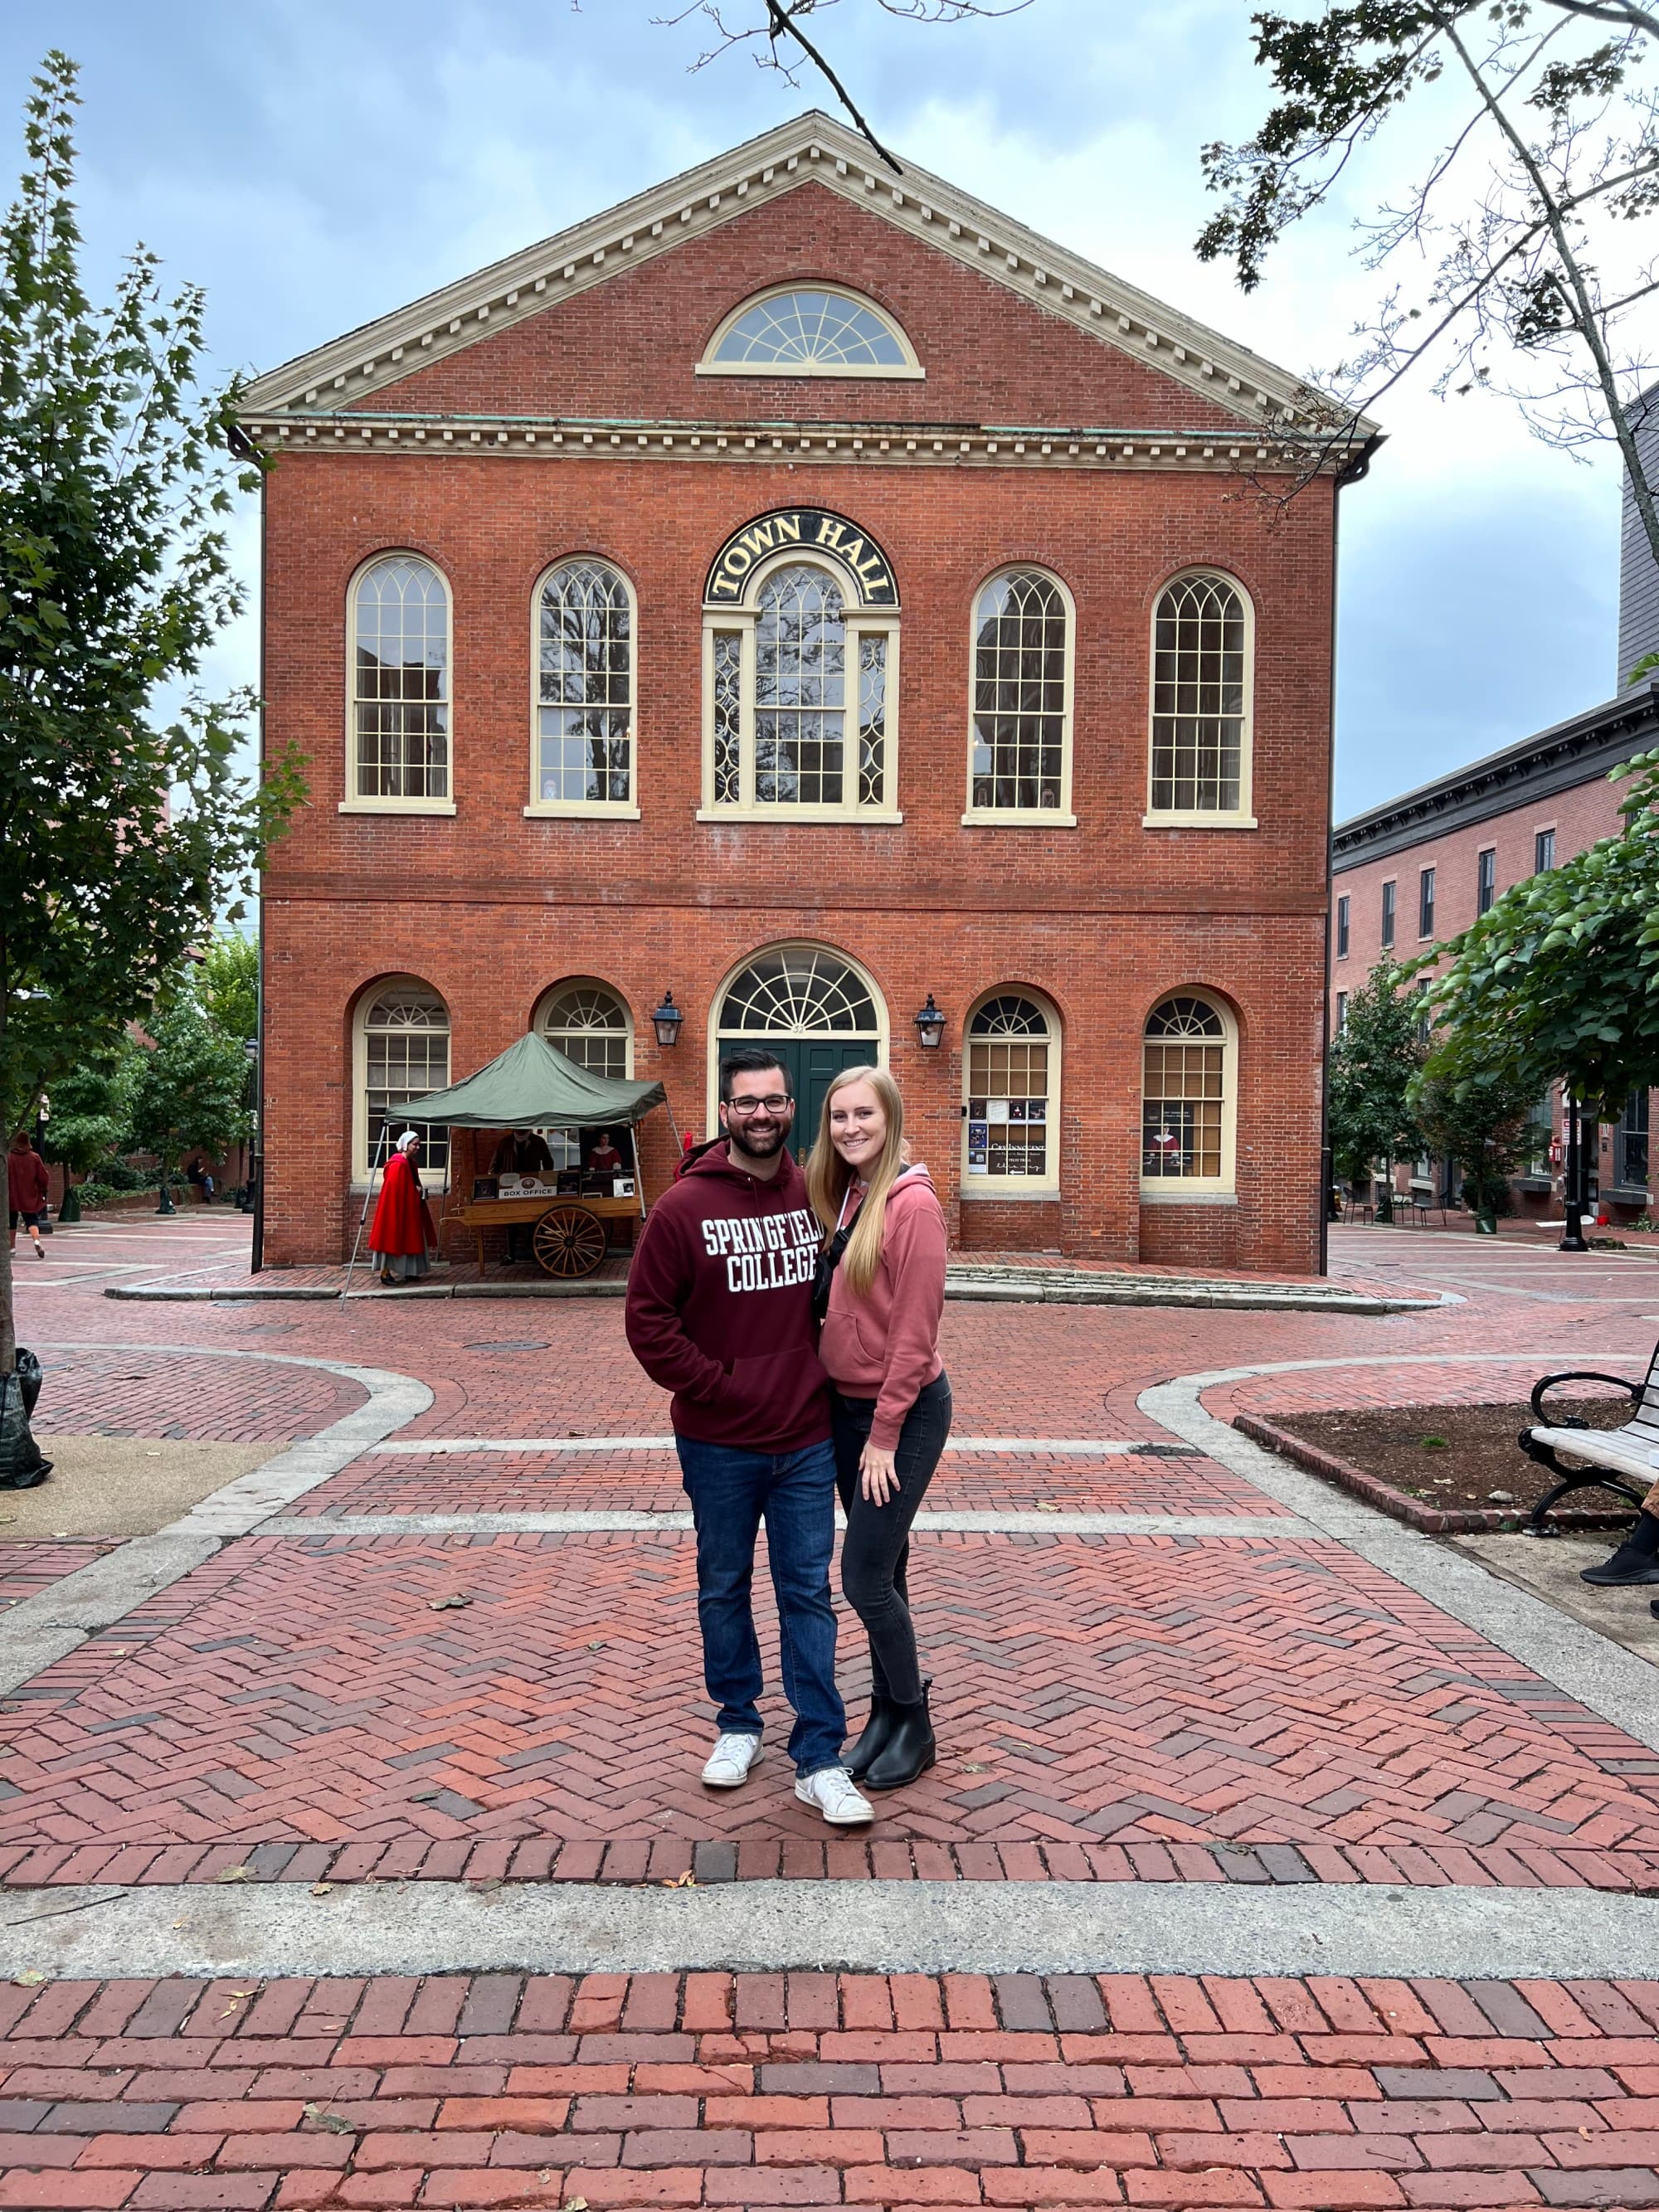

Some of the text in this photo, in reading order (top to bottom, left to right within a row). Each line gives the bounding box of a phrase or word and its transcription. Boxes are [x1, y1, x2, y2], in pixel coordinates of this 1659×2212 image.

[712, 514, 890, 600] TOWN HALL
[727, 1243, 819, 1293] COLLEGE
